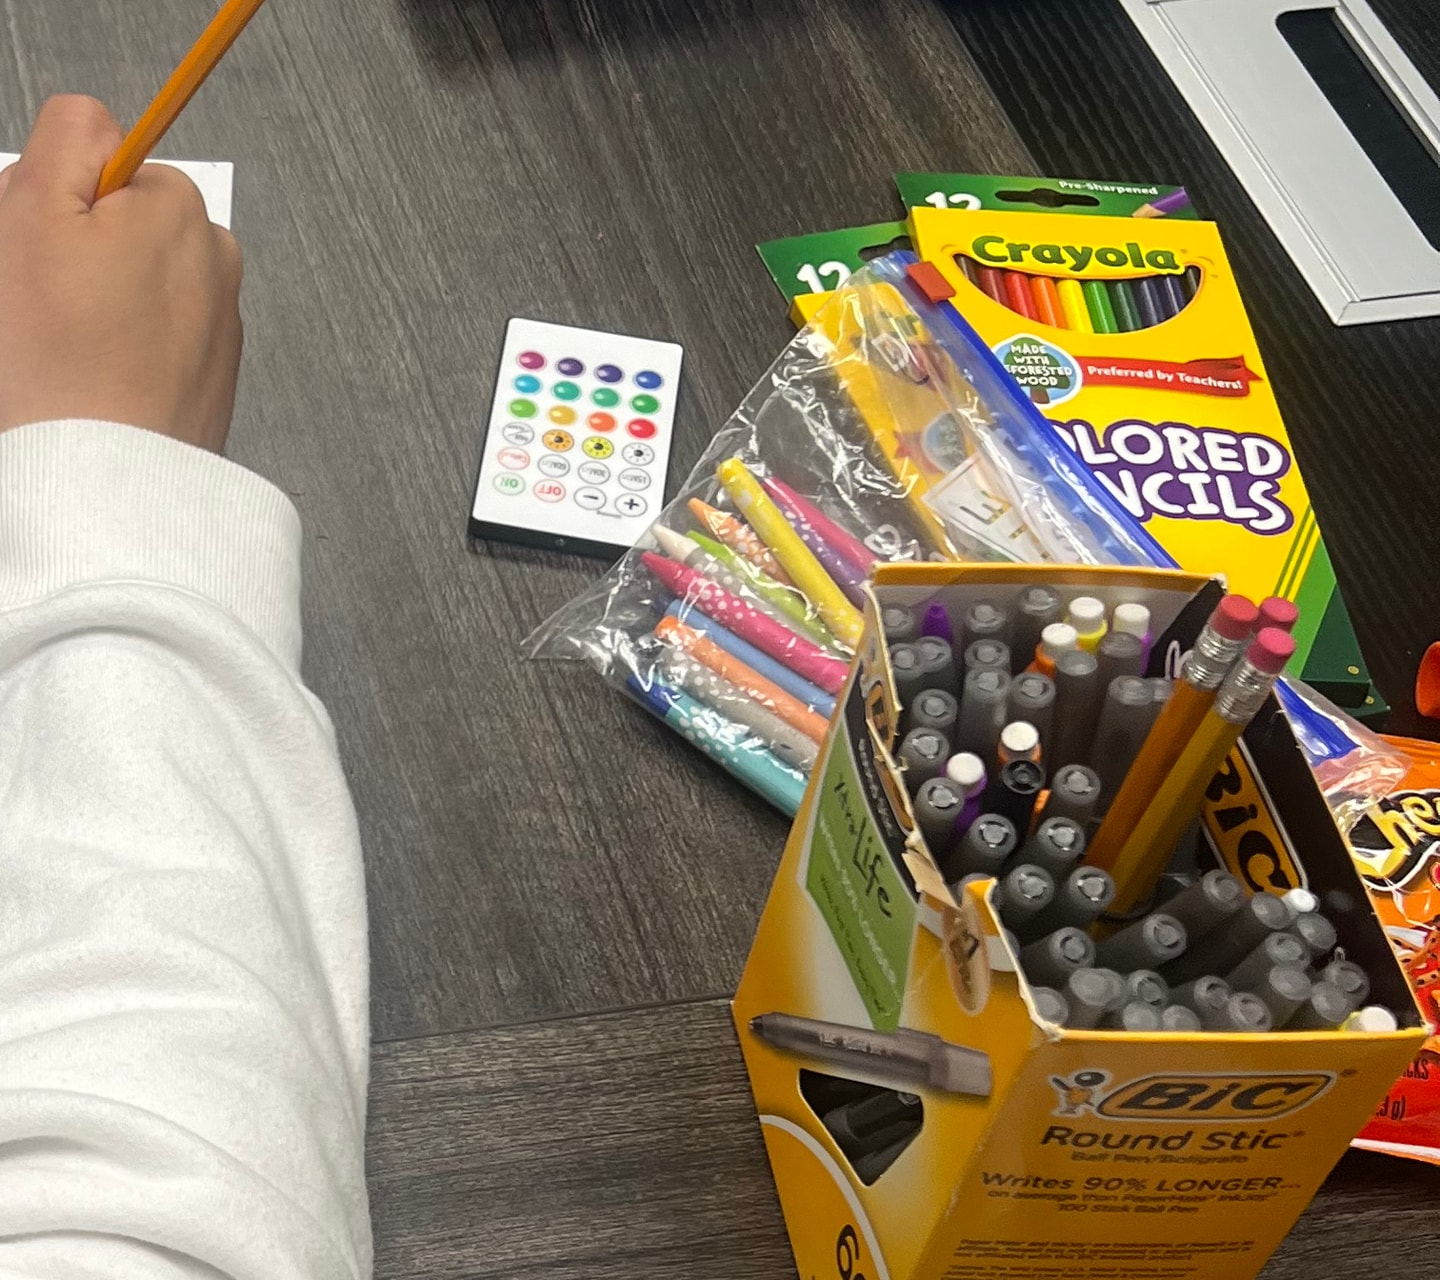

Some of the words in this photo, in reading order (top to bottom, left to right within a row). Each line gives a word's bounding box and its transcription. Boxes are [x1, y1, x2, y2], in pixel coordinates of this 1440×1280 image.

[1058, 180, 1158, 195] Pre-Sharpened
[972, 234, 1182, 273] Crayola
[1010, 343, 1046, 355] MADE
[1005, 364, 1072, 376] EFORESTED
[1013, 356, 1050, 366] WITH
[1015, 376, 1058, 386] WOOD
[1086, 365, 1154, 379] Preferred
[1156, 368, 1174, 382] by
[1176, 372, 1242, 389] Teachers!
[1052, 423, 1283, 476] LORED
[1094, 469, 1286, 530] NCILS
[1040, 1125, 1193, 1150] Round
[981, 1171, 1074, 1191] Writes
[1084, 1177, 1147, 1192] 90%
